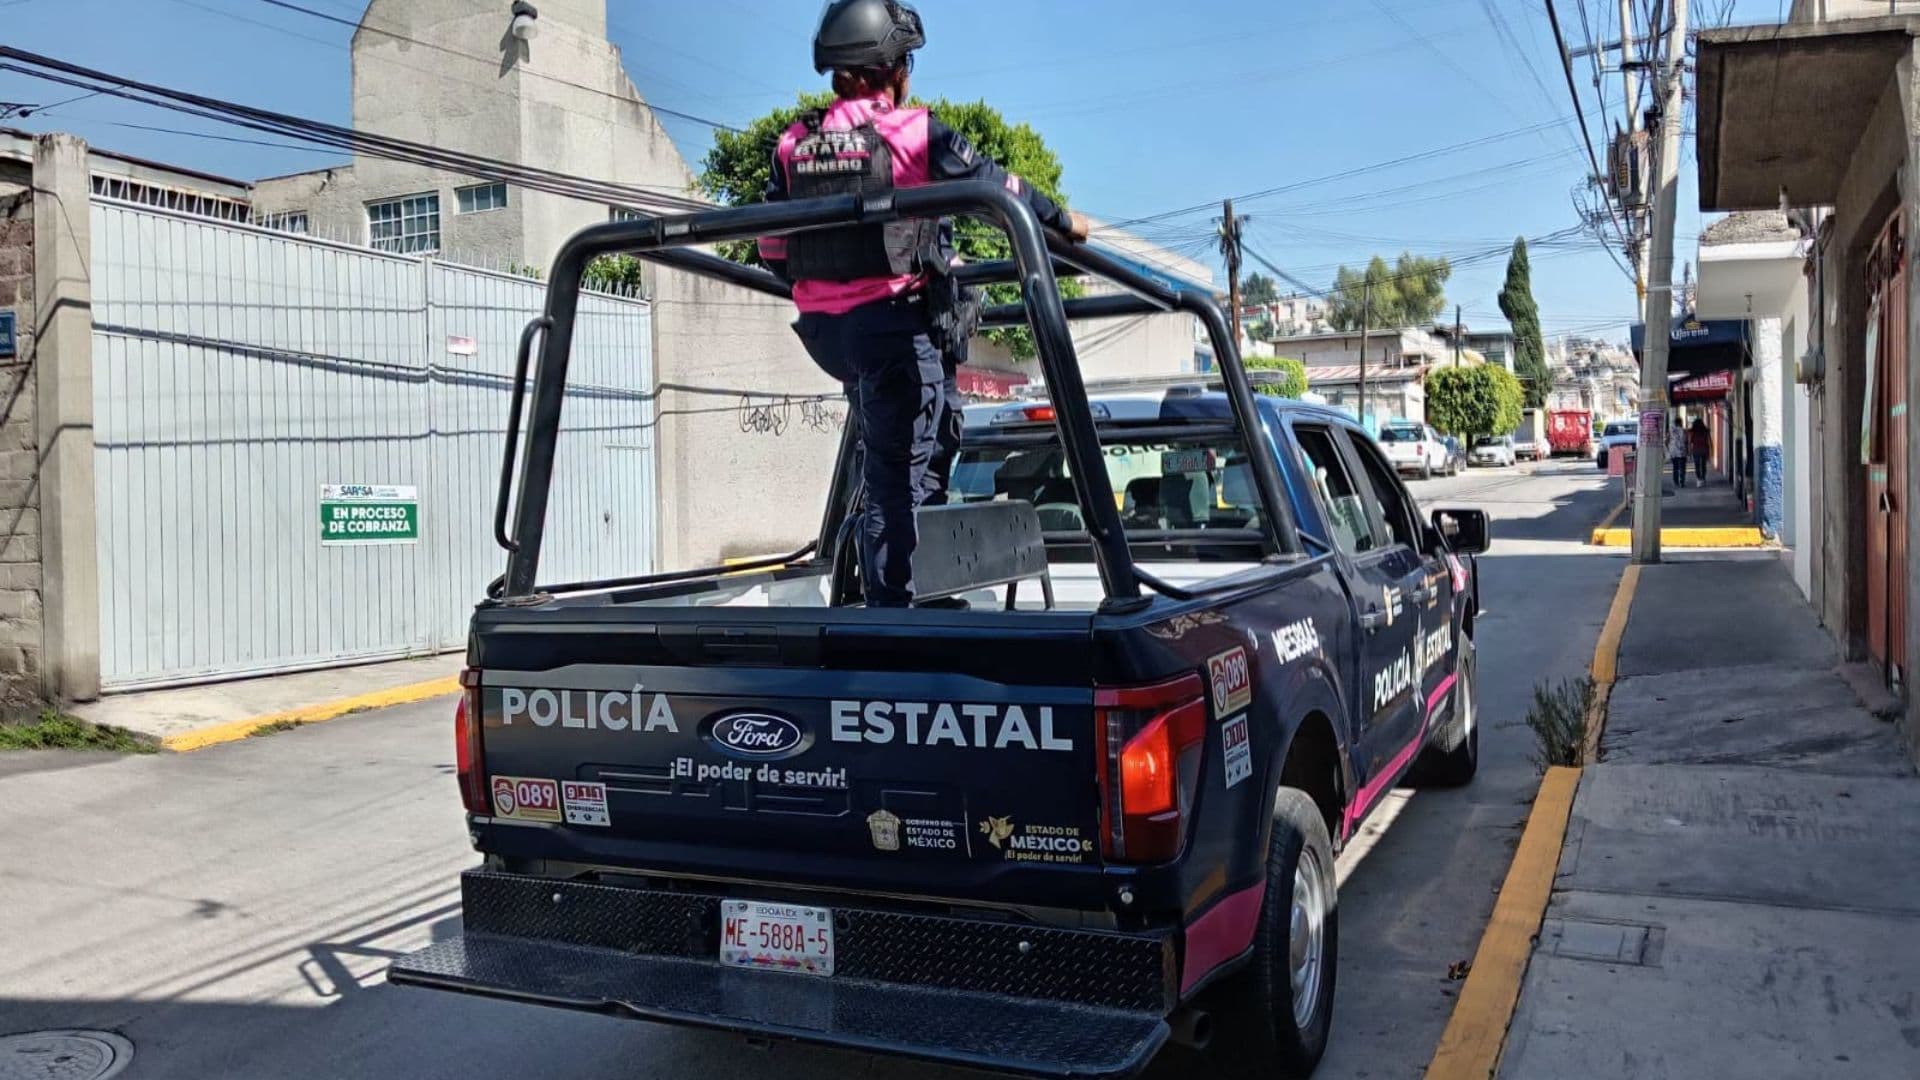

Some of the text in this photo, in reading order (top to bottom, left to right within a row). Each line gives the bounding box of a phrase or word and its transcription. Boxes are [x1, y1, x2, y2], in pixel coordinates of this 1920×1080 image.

[333, 507, 407, 519] EN PROCESO
[329, 521, 411, 533] DE COBRANZA
[1224, 655, 1247, 690] 089
[1374, 645, 1410, 712] POLICÍA
[502, 683, 1073, 750] POLICÍA ESTATAL
[726, 717, 783, 748] Ford
[1226, 723, 1247, 747] 911
[670, 757, 846, 787] ¡El poder de servir!
[518, 783, 555, 808] 089
[567, 785, 601, 801] 911
[905, 818, 939, 826] GOBIERNO
[906, 827, 955, 837] ESTADO DE
[1025, 825, 1080, 837] ESTADO DE
[907, 836, 956, 849] MÉXICO
[1010, 835, 1081, 852] MÉXICO
[1017, 852, 1041, 862] poder
[1043, 852, 1054, 861] de
[725, 917, 829, 955] ME-588A-5
